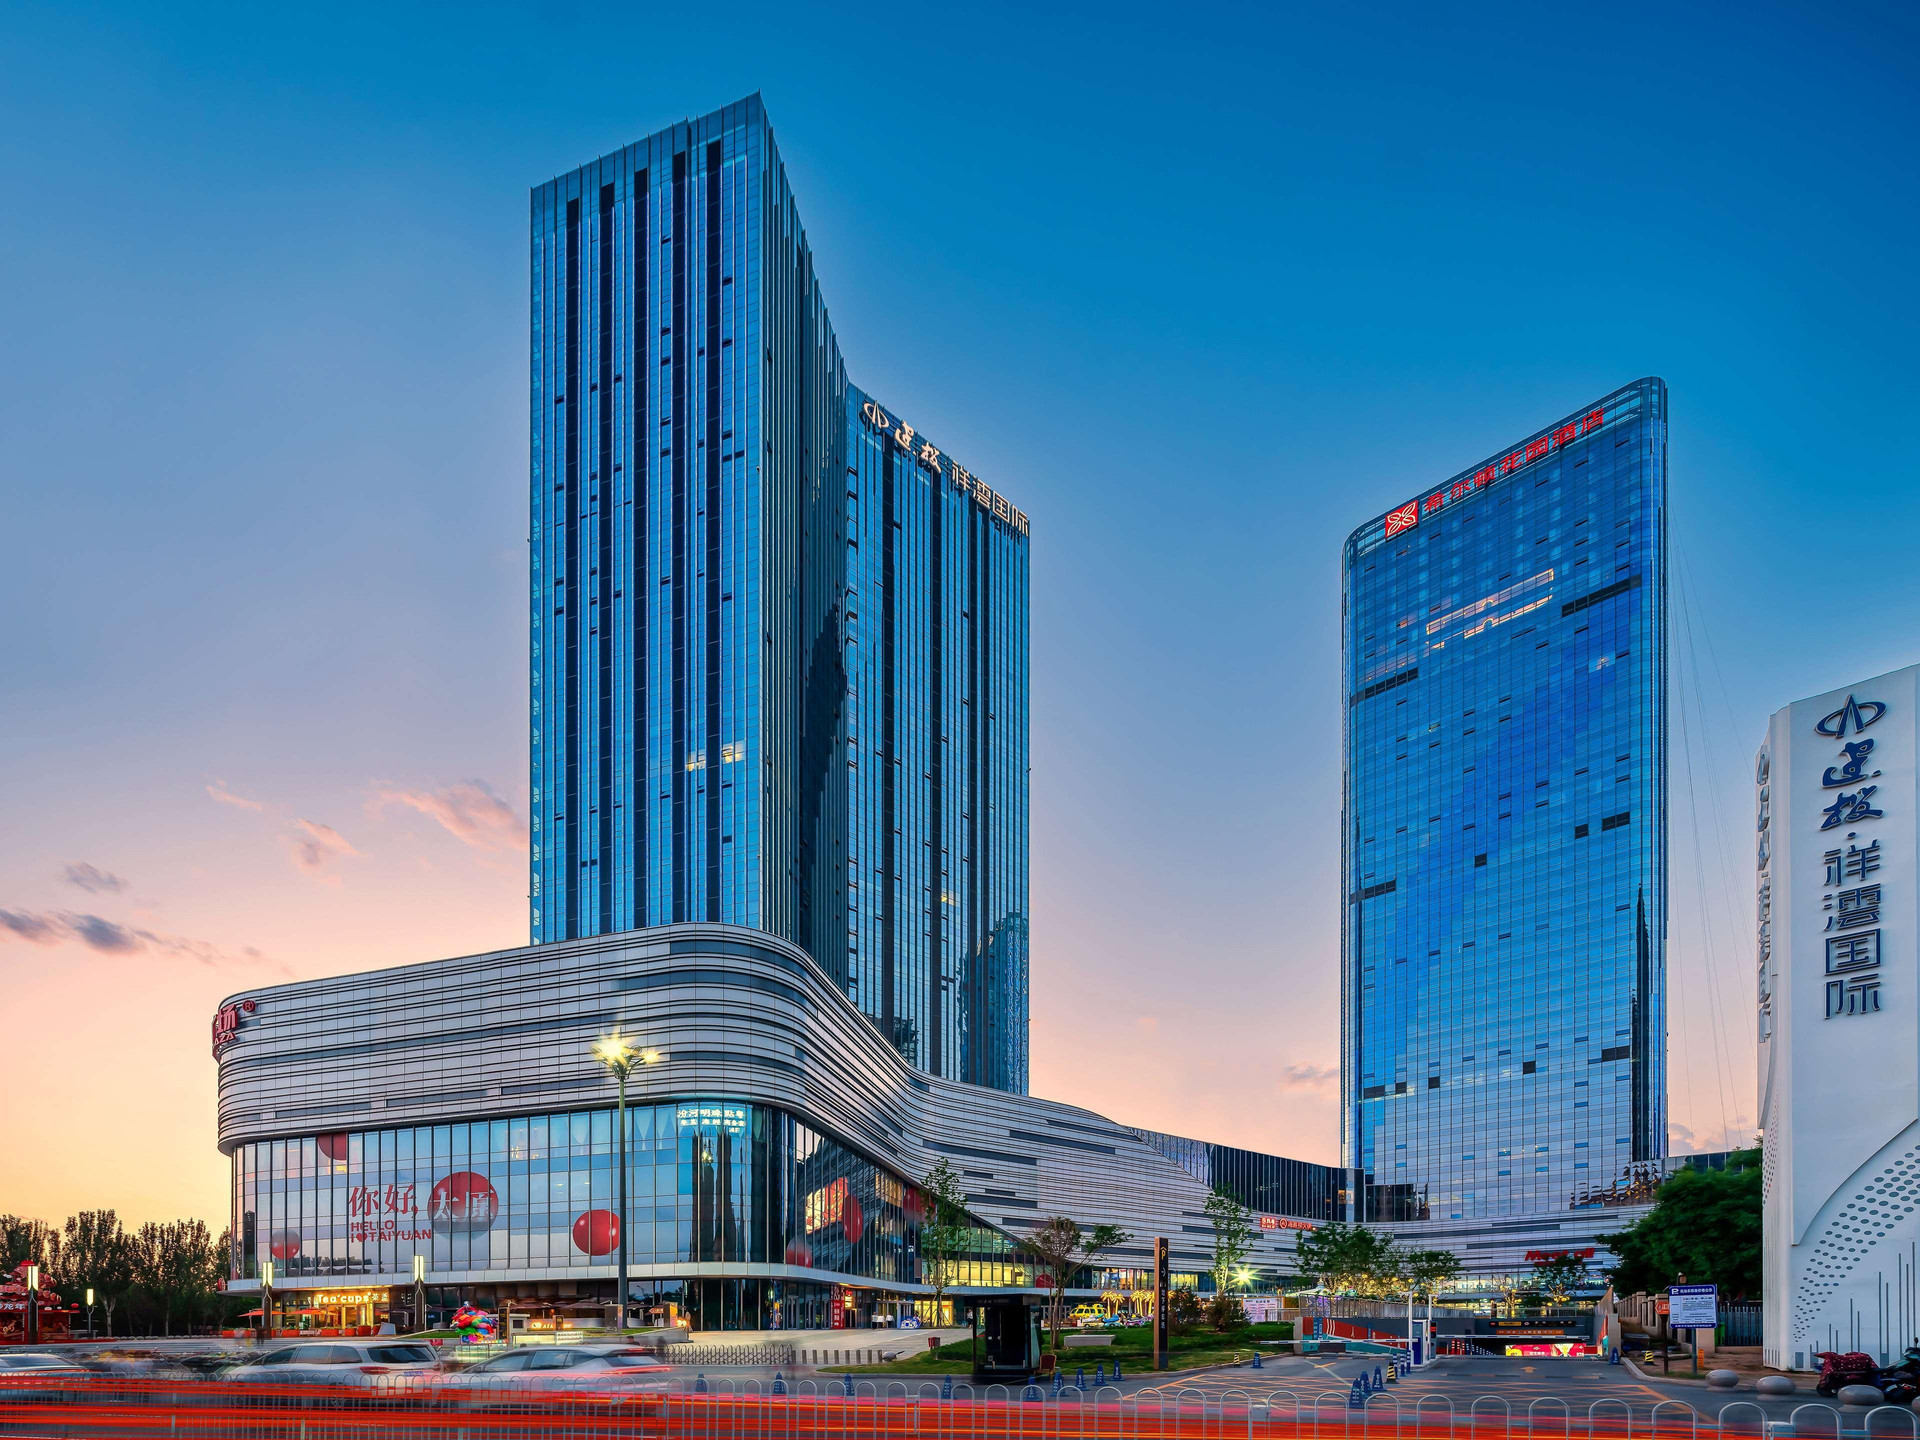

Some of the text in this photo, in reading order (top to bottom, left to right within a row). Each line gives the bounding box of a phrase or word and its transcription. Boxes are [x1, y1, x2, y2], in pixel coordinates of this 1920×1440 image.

[1423, 407, 1605, 513] 希尔顿花园酒店
[429, 1191, 495, 1223] 太原
[350, 1219, 395, 1232] HELLO
[368, 1229, 432, 1242] TAIYUAN
